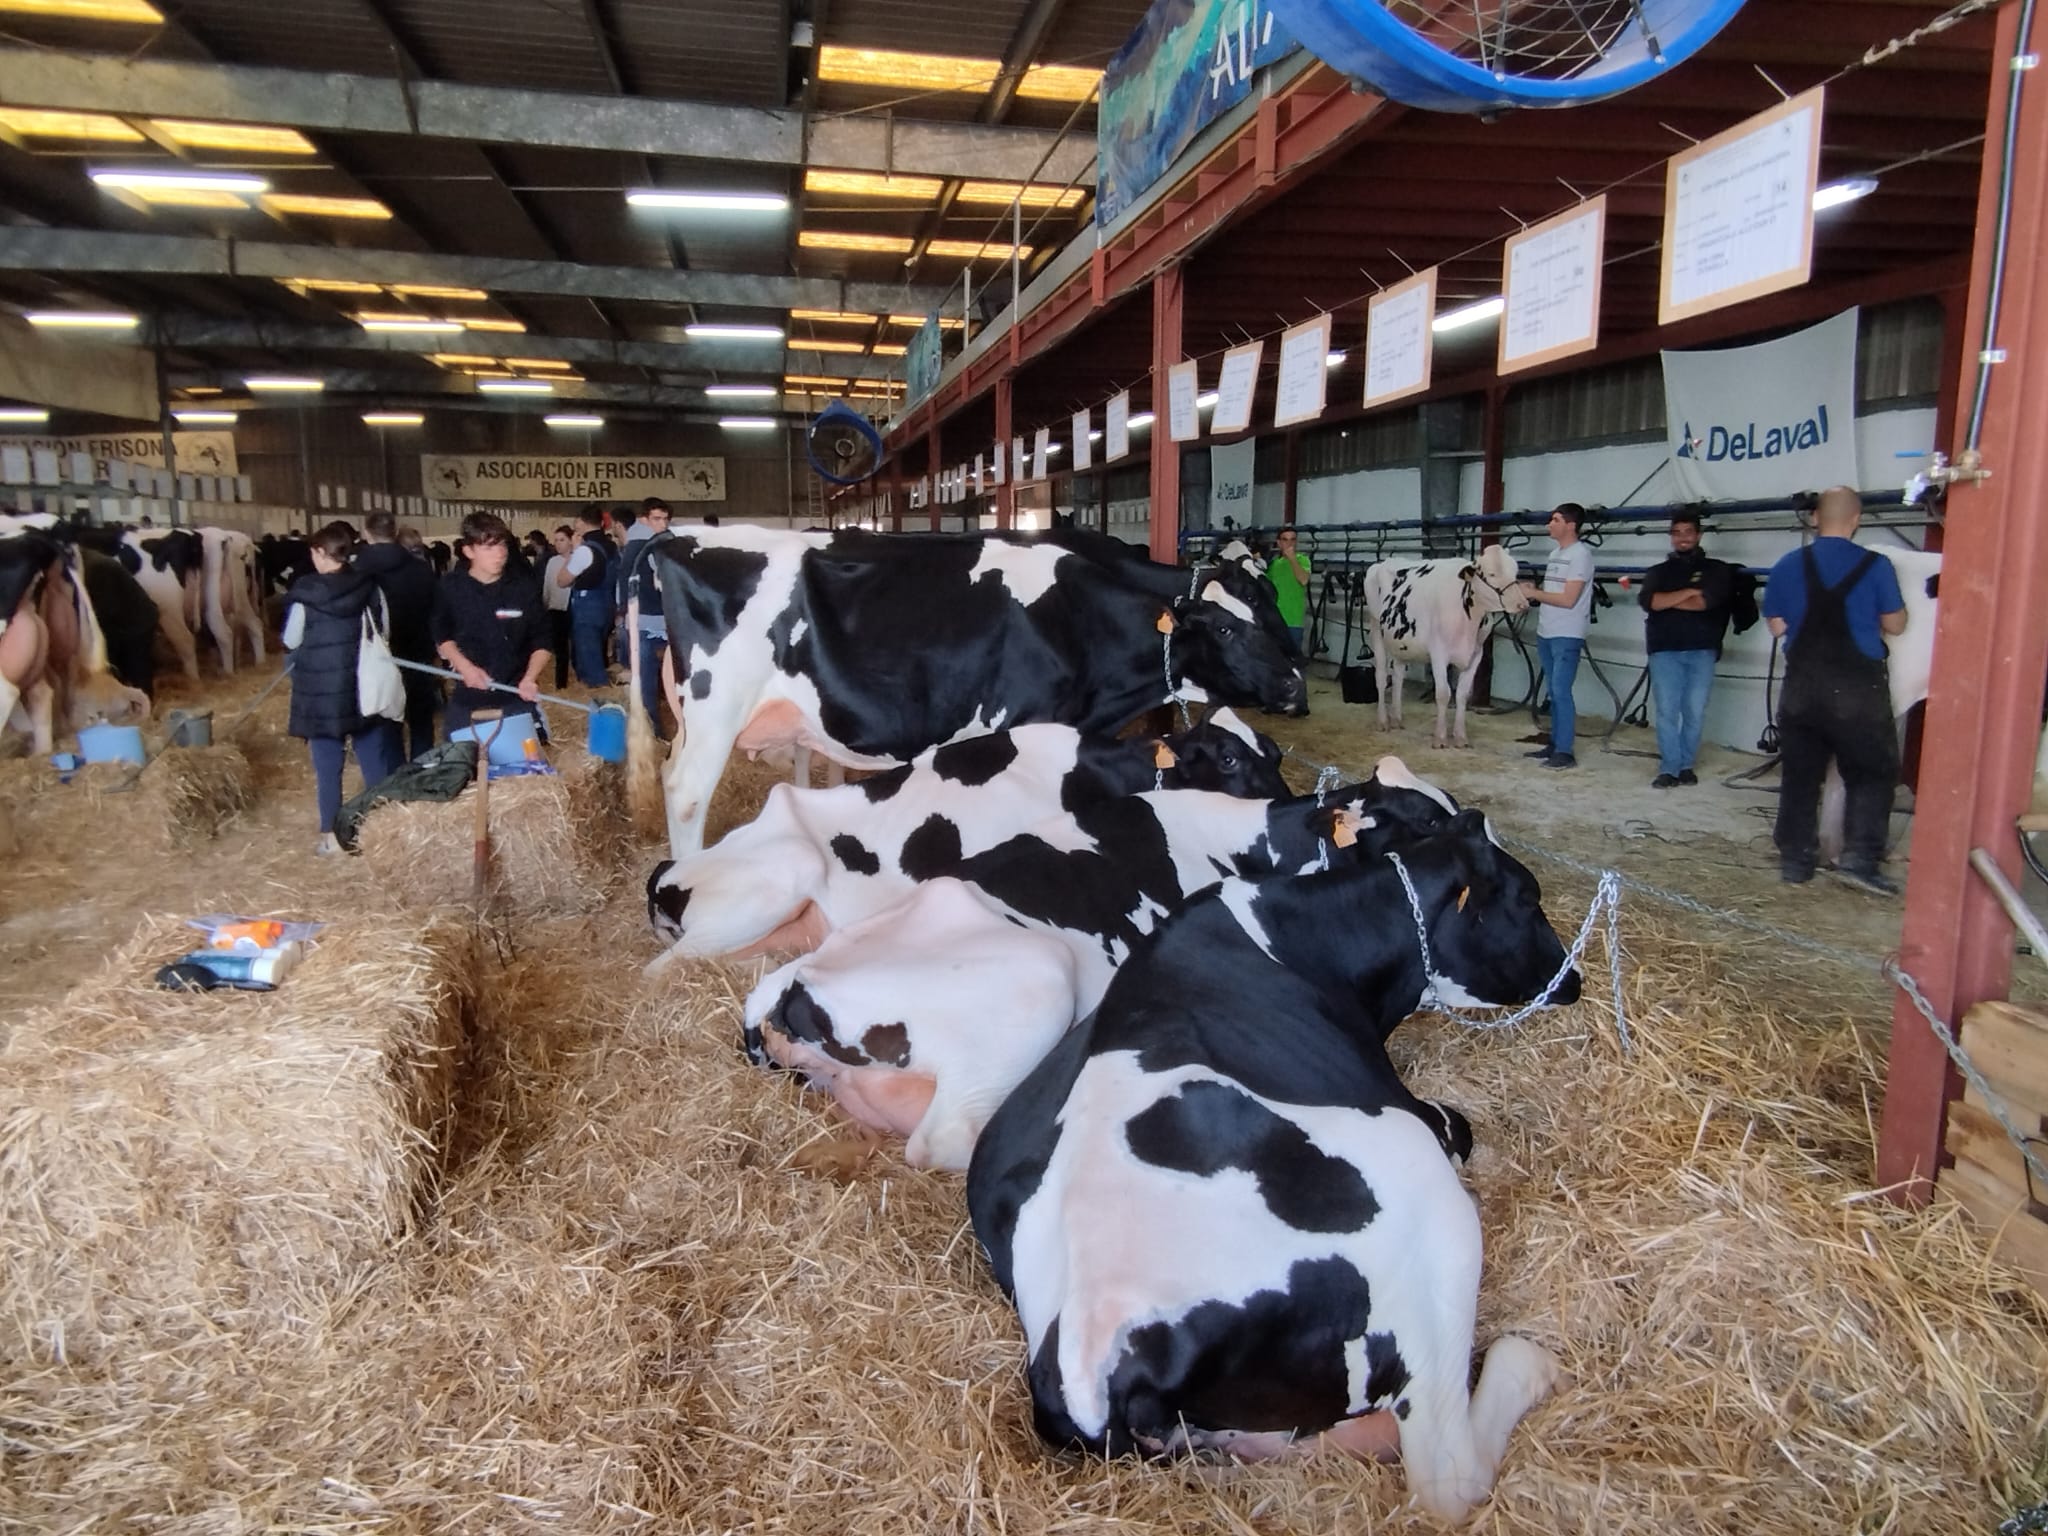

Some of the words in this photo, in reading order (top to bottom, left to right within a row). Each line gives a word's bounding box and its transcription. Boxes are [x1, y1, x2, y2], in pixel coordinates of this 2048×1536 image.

[1706, 404, 1829, 462] DeLaval
[476, 459, 589, 480] ASOCIACIÓN
[594, 462, 676, 480] FRISONA
[541, 481, 612, 498] BALEAR
